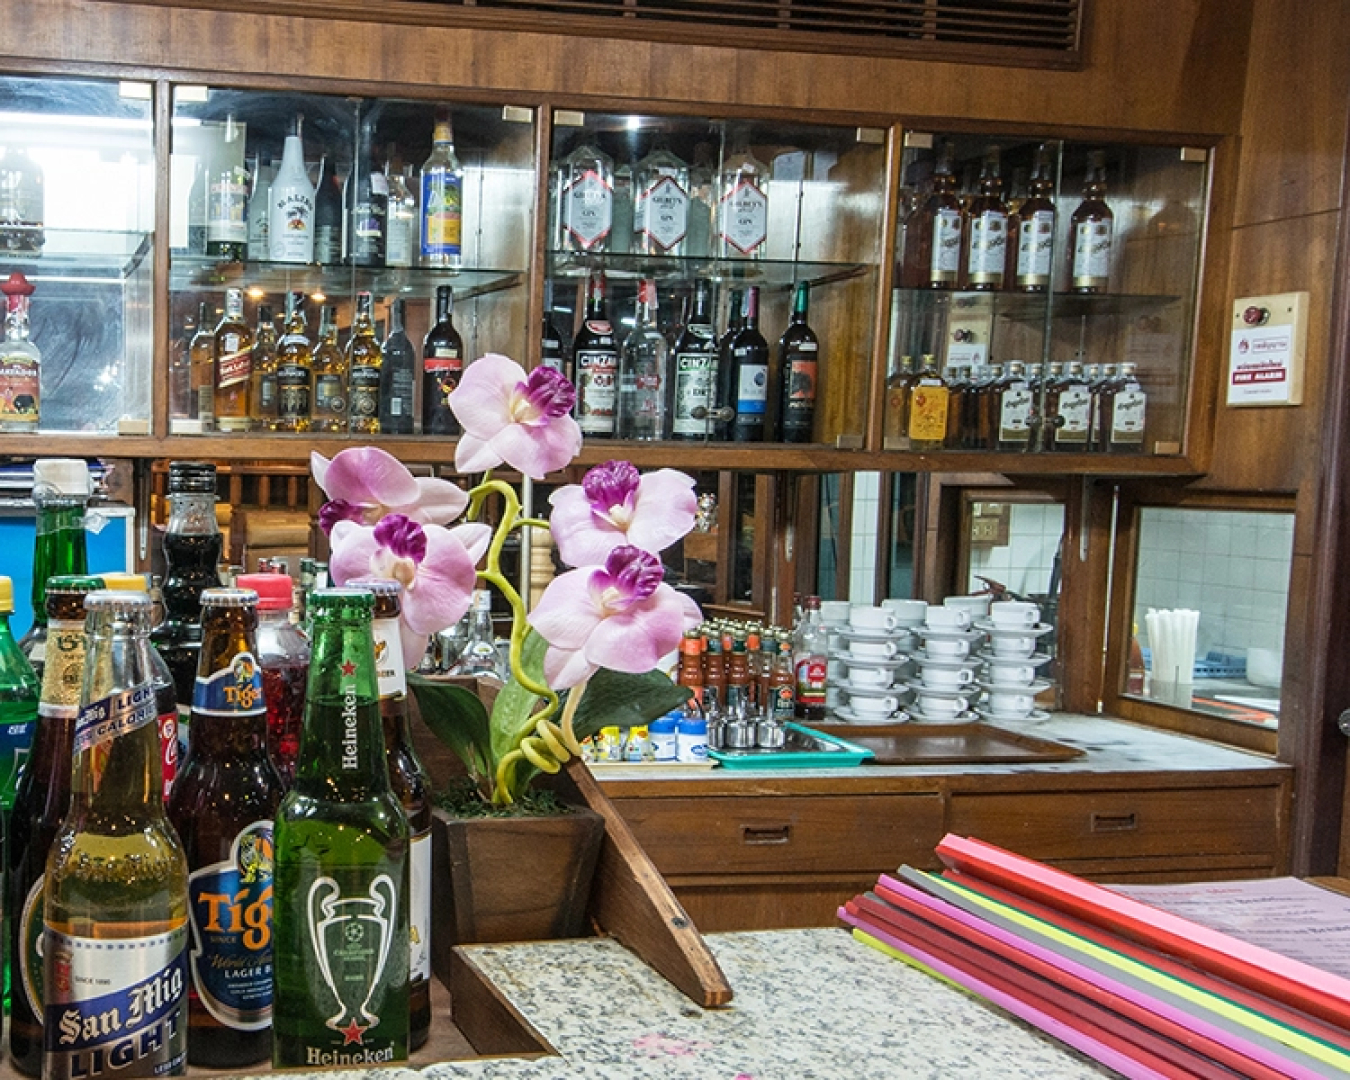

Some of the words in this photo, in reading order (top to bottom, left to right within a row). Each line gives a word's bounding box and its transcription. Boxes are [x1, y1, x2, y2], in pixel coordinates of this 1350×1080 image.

[342, 683, 357, 769] Heineken
[198, 885, 273, 950] Tig
[224, 966, 262, 978] LAGER
[58, 1007, 123, 1045] San
[125, 967, 183, 1029] Mig
[70, 1010, 181, 1080] LIGHT
[306, 1044, 394, 1065] Heineken
